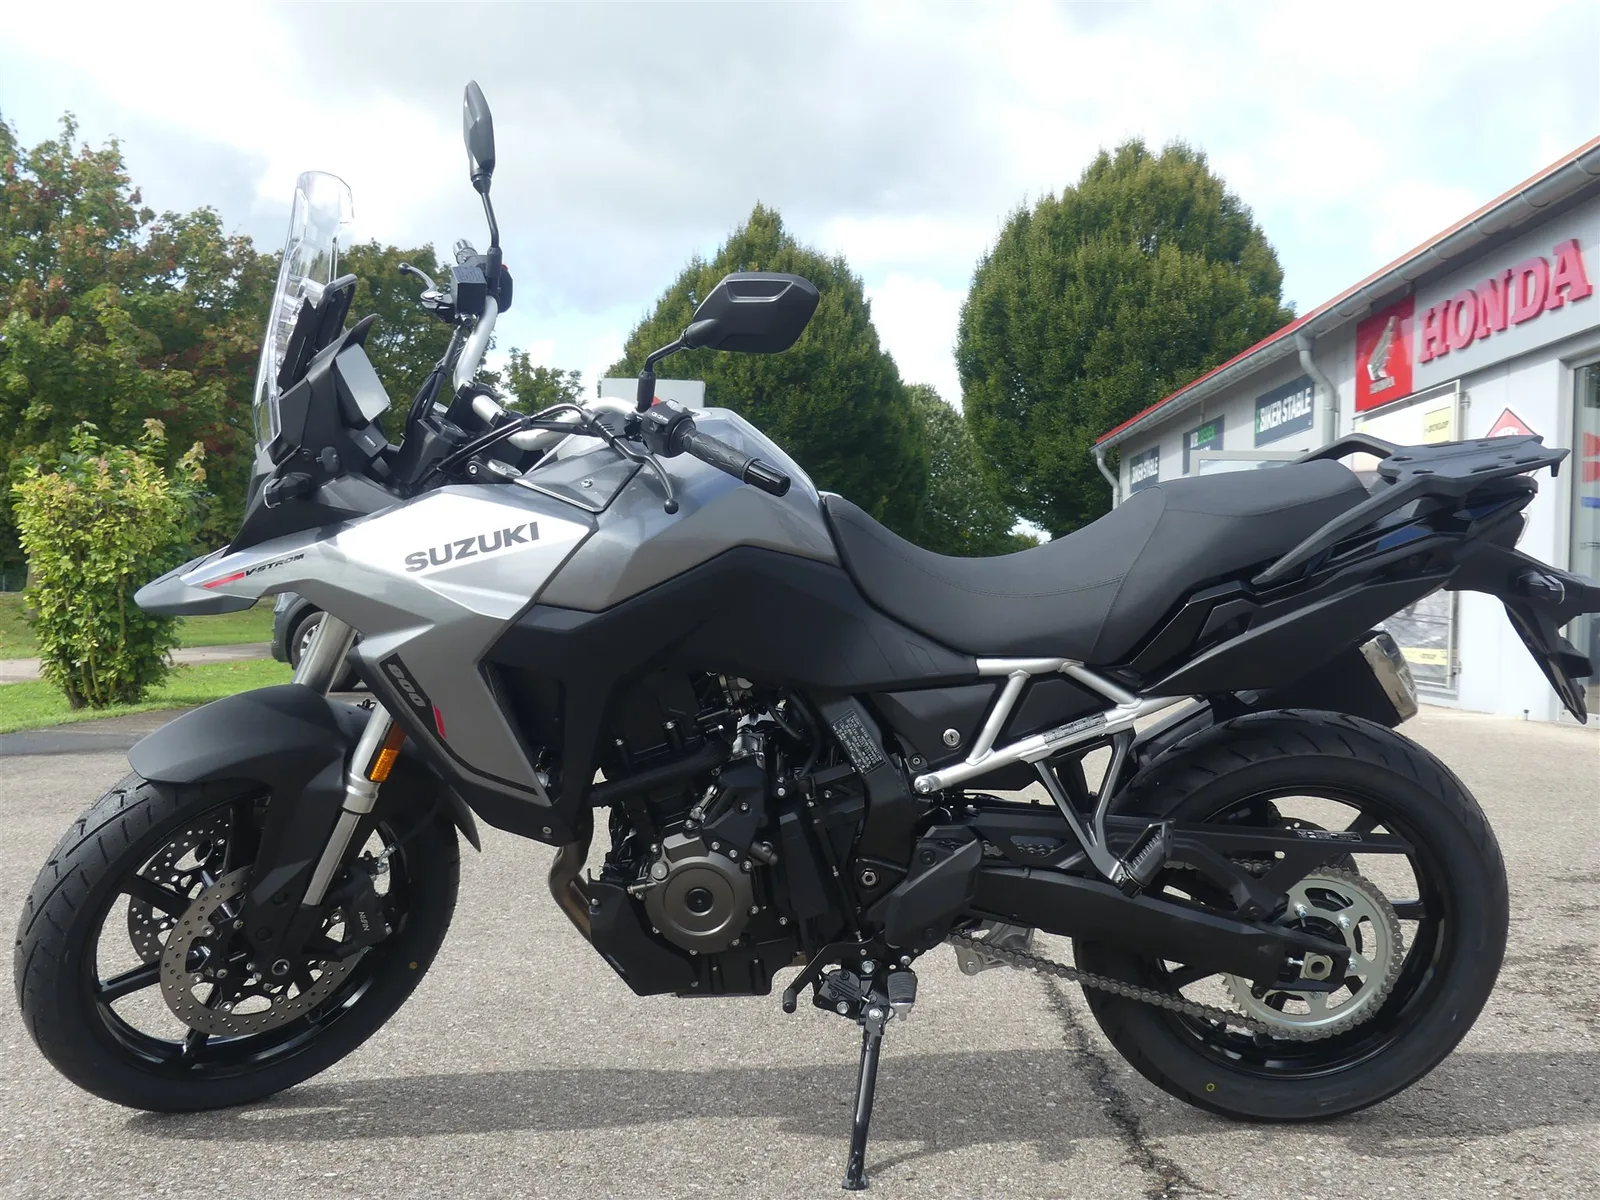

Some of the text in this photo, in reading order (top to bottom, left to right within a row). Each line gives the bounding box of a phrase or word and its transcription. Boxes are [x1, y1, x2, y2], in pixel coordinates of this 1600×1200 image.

[1419, 238, 1593, 364] HONDA
[1282, 387, 1311, 423] STABLE
[245, 553, 305, 577] V-STROM
[404, 521, 540, 574] SUZUKI
[387, 663, 427, 708] 800
